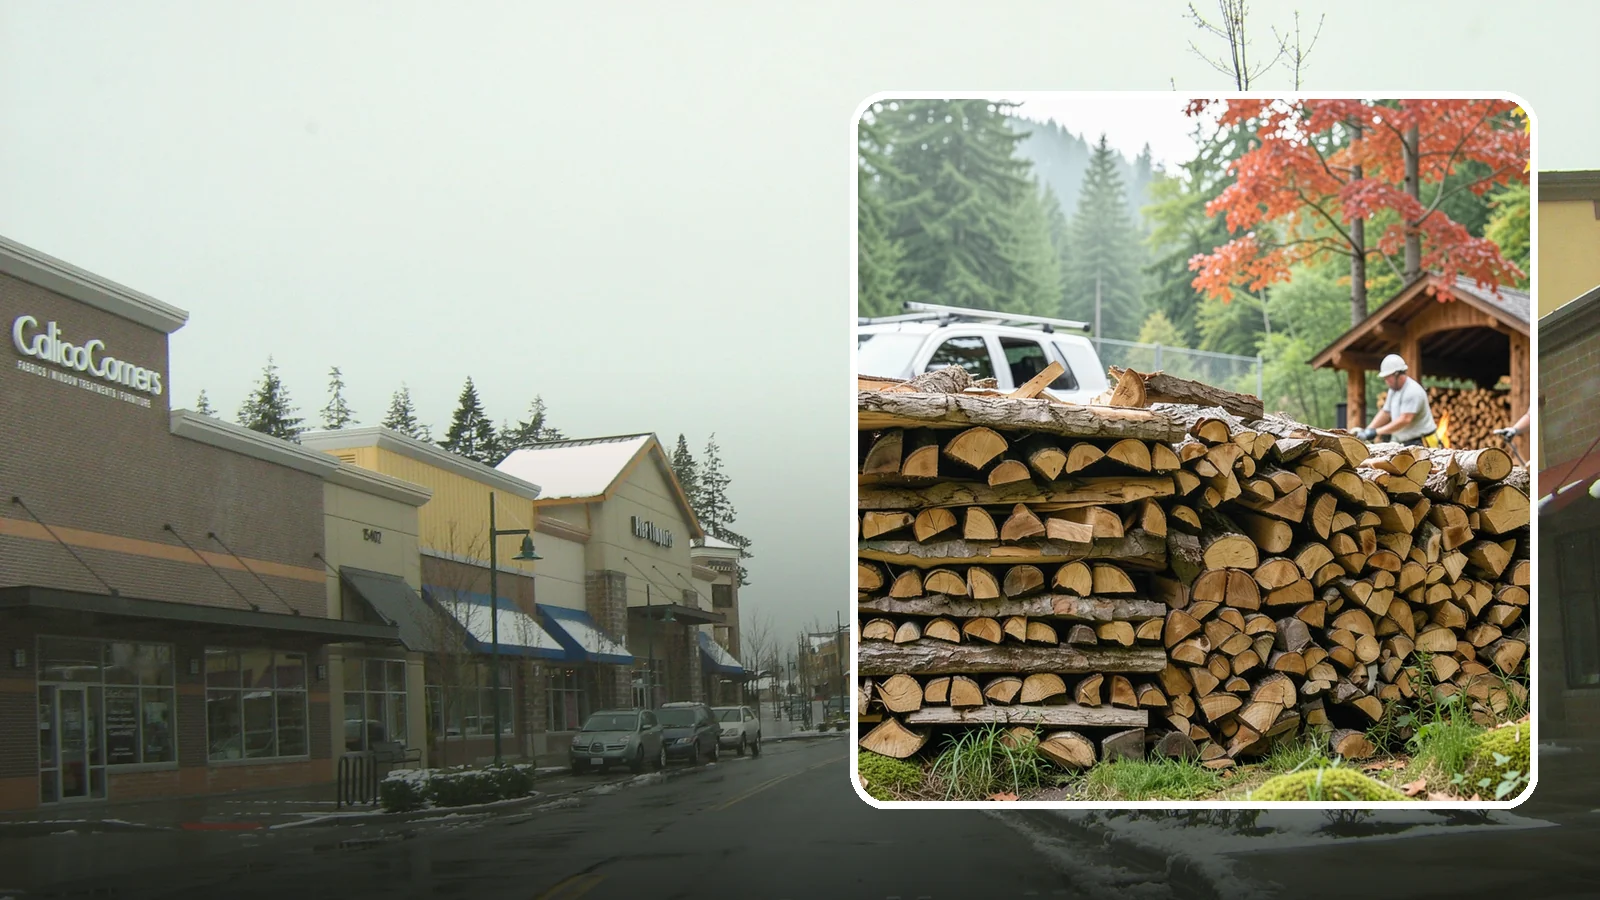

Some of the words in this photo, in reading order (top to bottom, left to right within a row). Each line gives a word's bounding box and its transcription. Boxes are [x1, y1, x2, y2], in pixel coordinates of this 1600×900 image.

[16, 360, 46, 378] FABRICS
[51, 370, 78, 386] WINDOW
[79, 379, 116, 398] TREATMENTS
